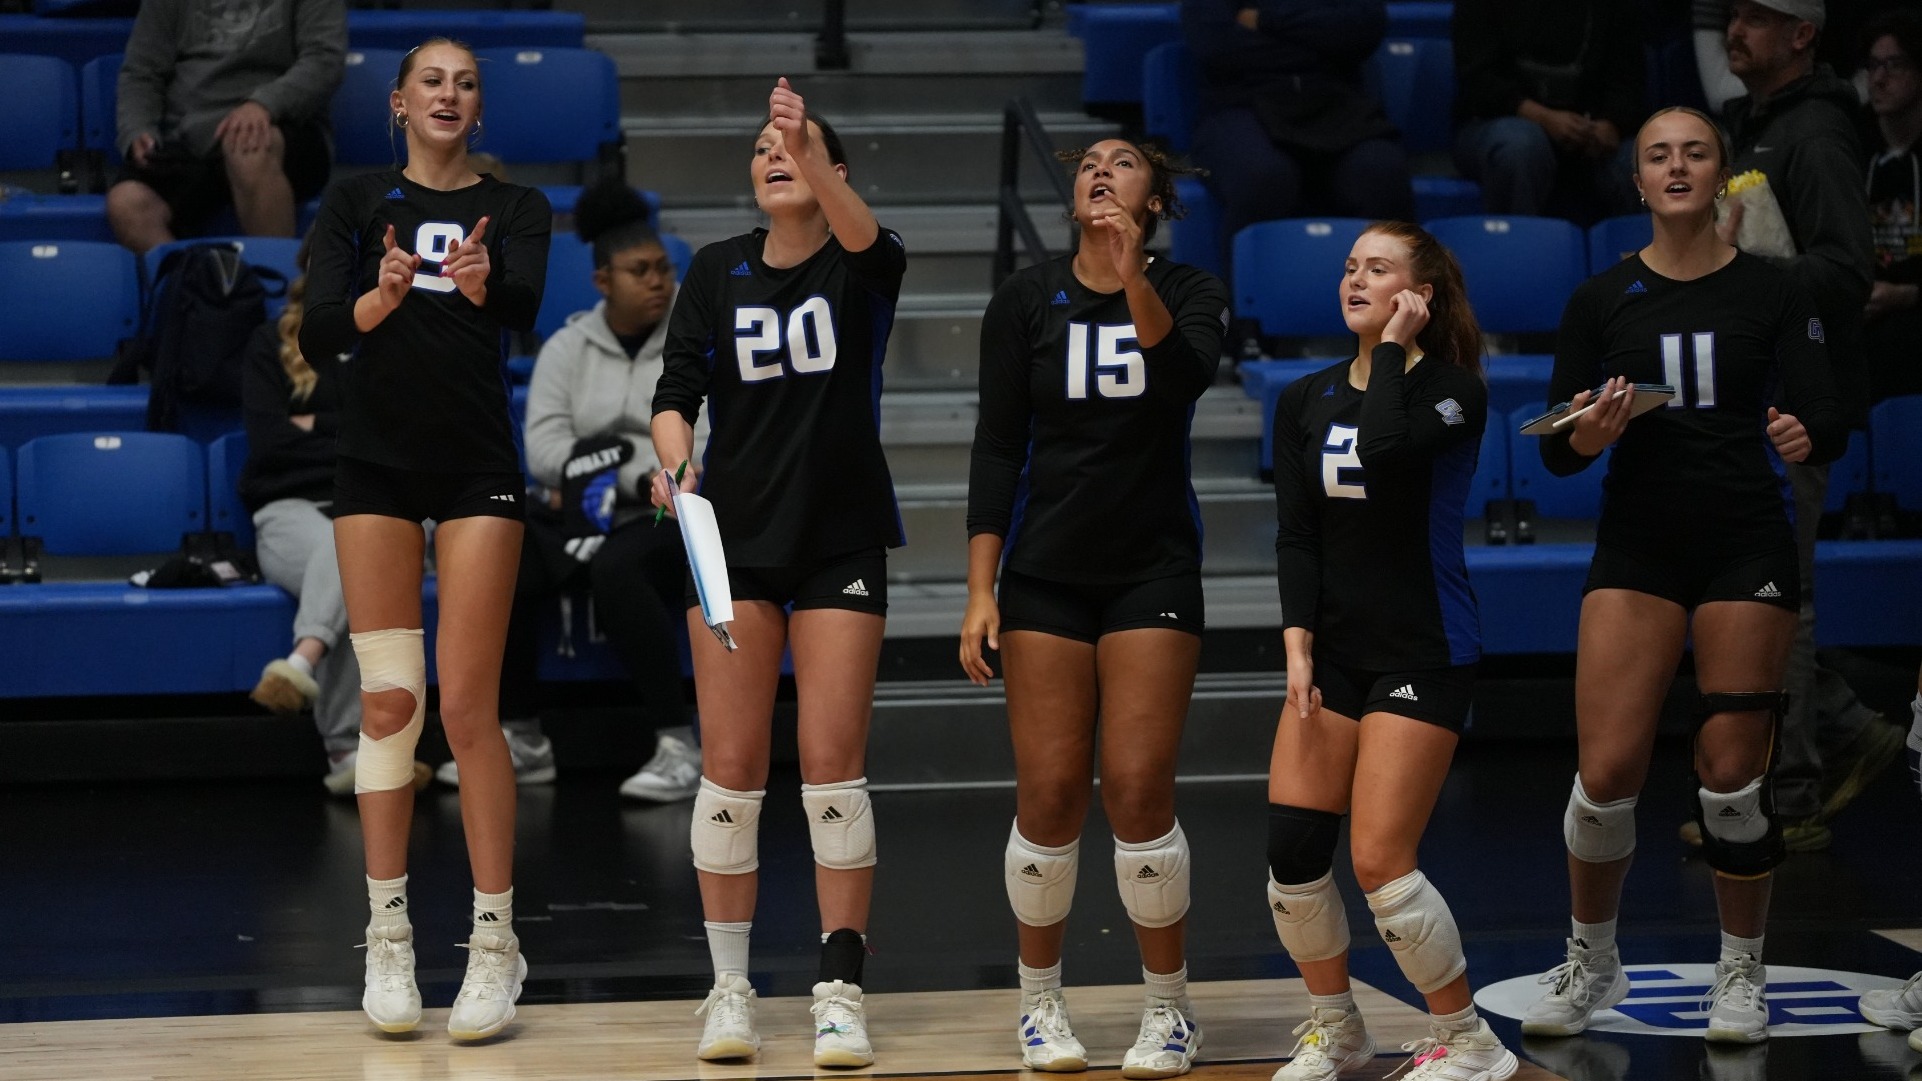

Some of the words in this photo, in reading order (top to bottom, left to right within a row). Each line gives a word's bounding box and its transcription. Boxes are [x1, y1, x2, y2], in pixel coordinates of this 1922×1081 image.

[410, 220, 466, 294] 9
[734, 293, 838, 384] 20
[1065, 320, 1148, 401] 15
[1660, 332, 1718, 410] 11
[1320, 420, 1369, 501] 2
[842, 588, 870, 597] adidas
[1389, 692, 1419, 701] adidas
[1136, 867, 1160, 879] adidas
